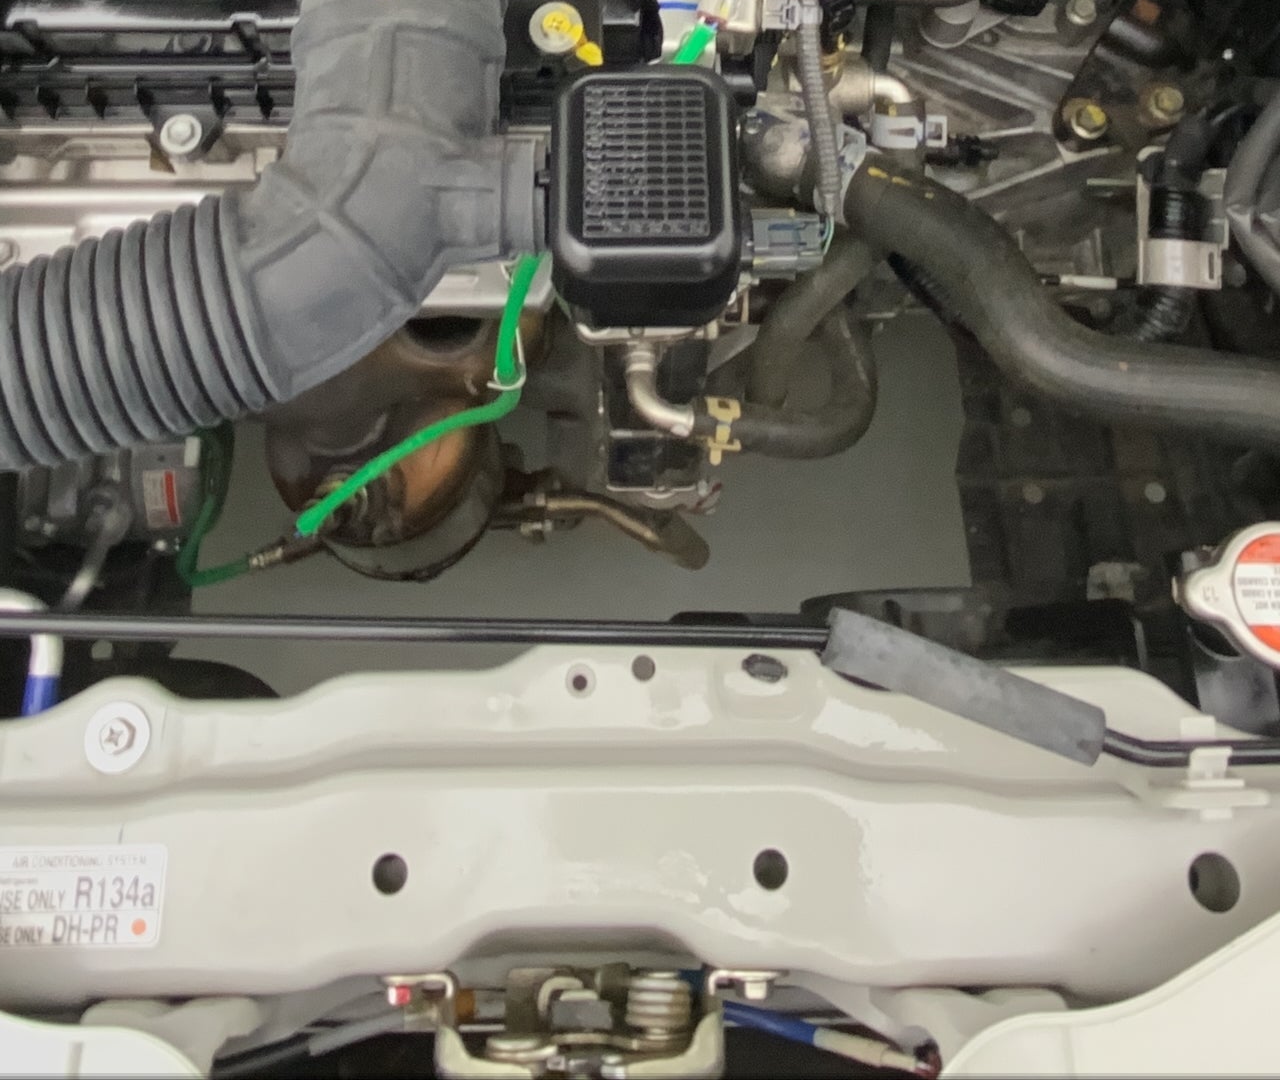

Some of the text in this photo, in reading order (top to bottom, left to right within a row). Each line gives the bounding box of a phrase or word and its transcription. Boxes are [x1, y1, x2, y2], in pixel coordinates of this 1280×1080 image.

[11, 855, 30, 869] AIR
[27, 889, 66, 911] ONLY
[74, 875, 155, 909] R134a
[14, 925, 44, 943] ONLY
[52, 914, 119, 944] DH-PR
